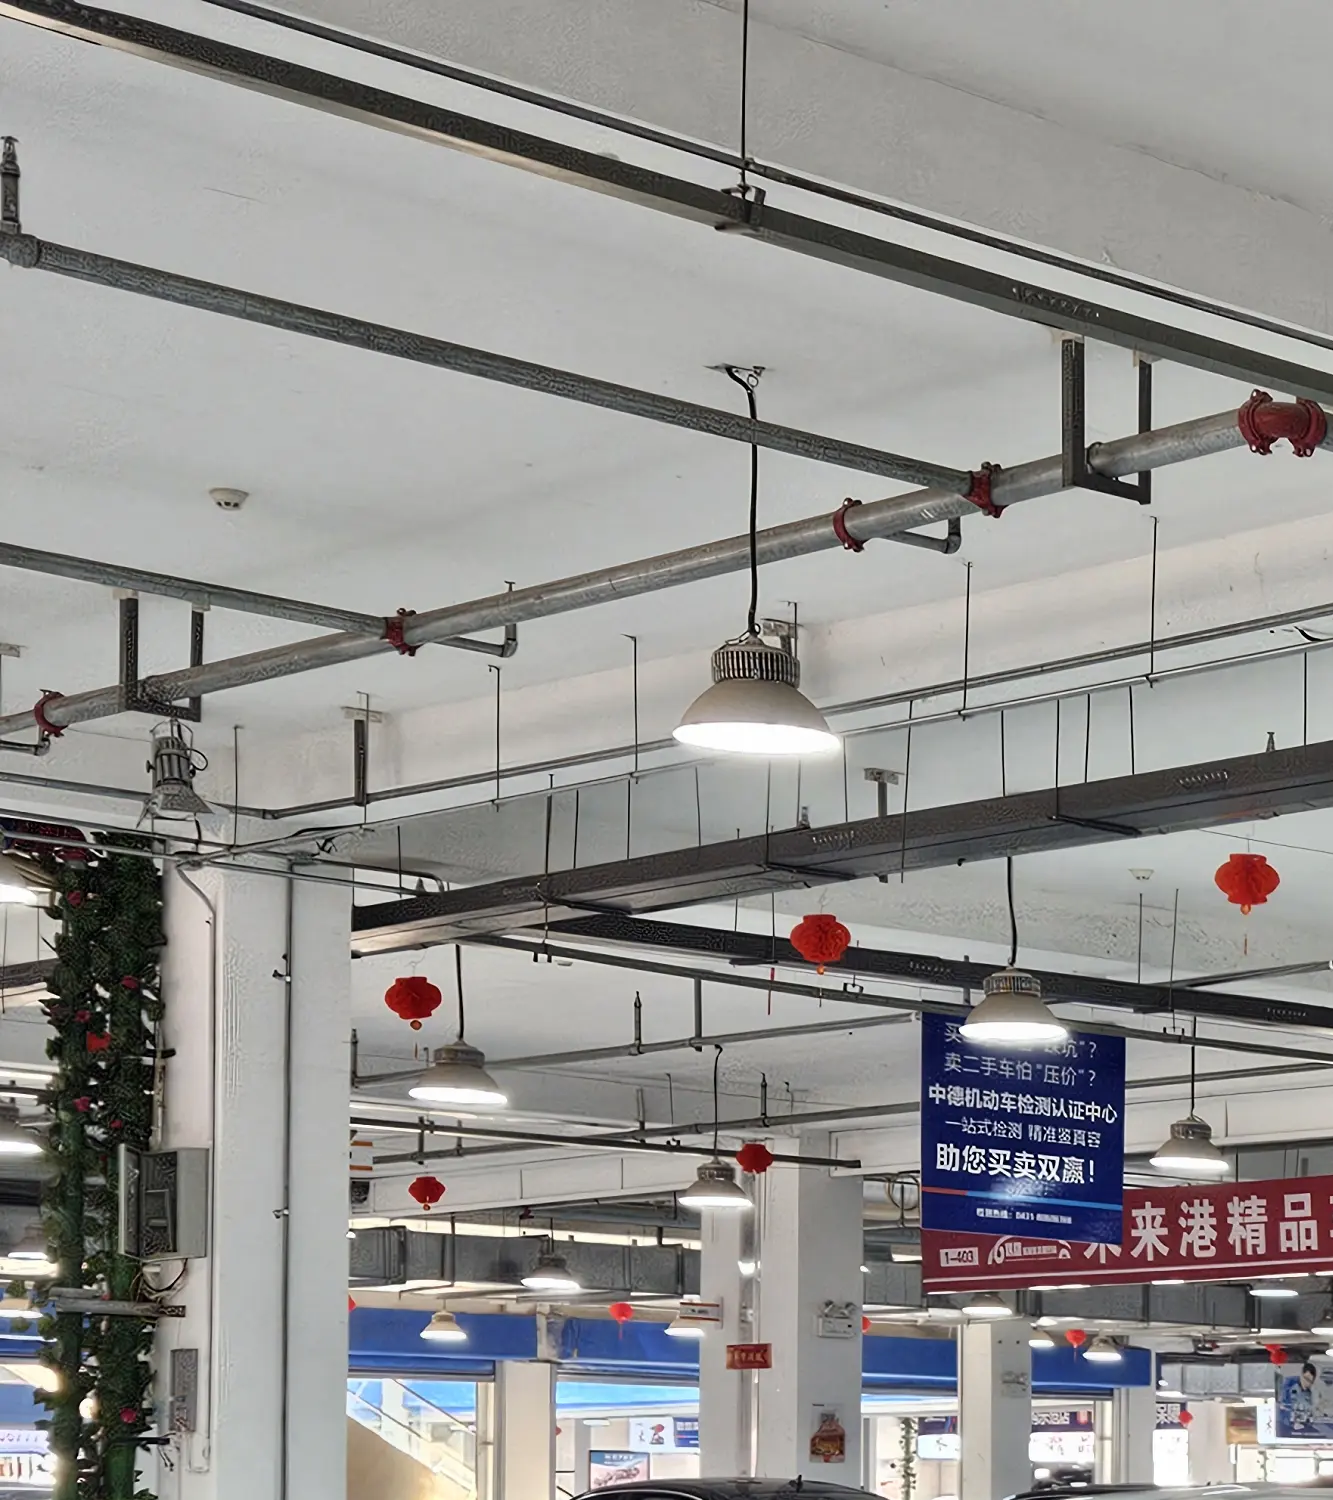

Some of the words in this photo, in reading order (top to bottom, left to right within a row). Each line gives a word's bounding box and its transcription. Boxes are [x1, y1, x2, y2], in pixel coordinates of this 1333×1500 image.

[928, 1083, 1118, 1124] 中德机动车检测认证中心
